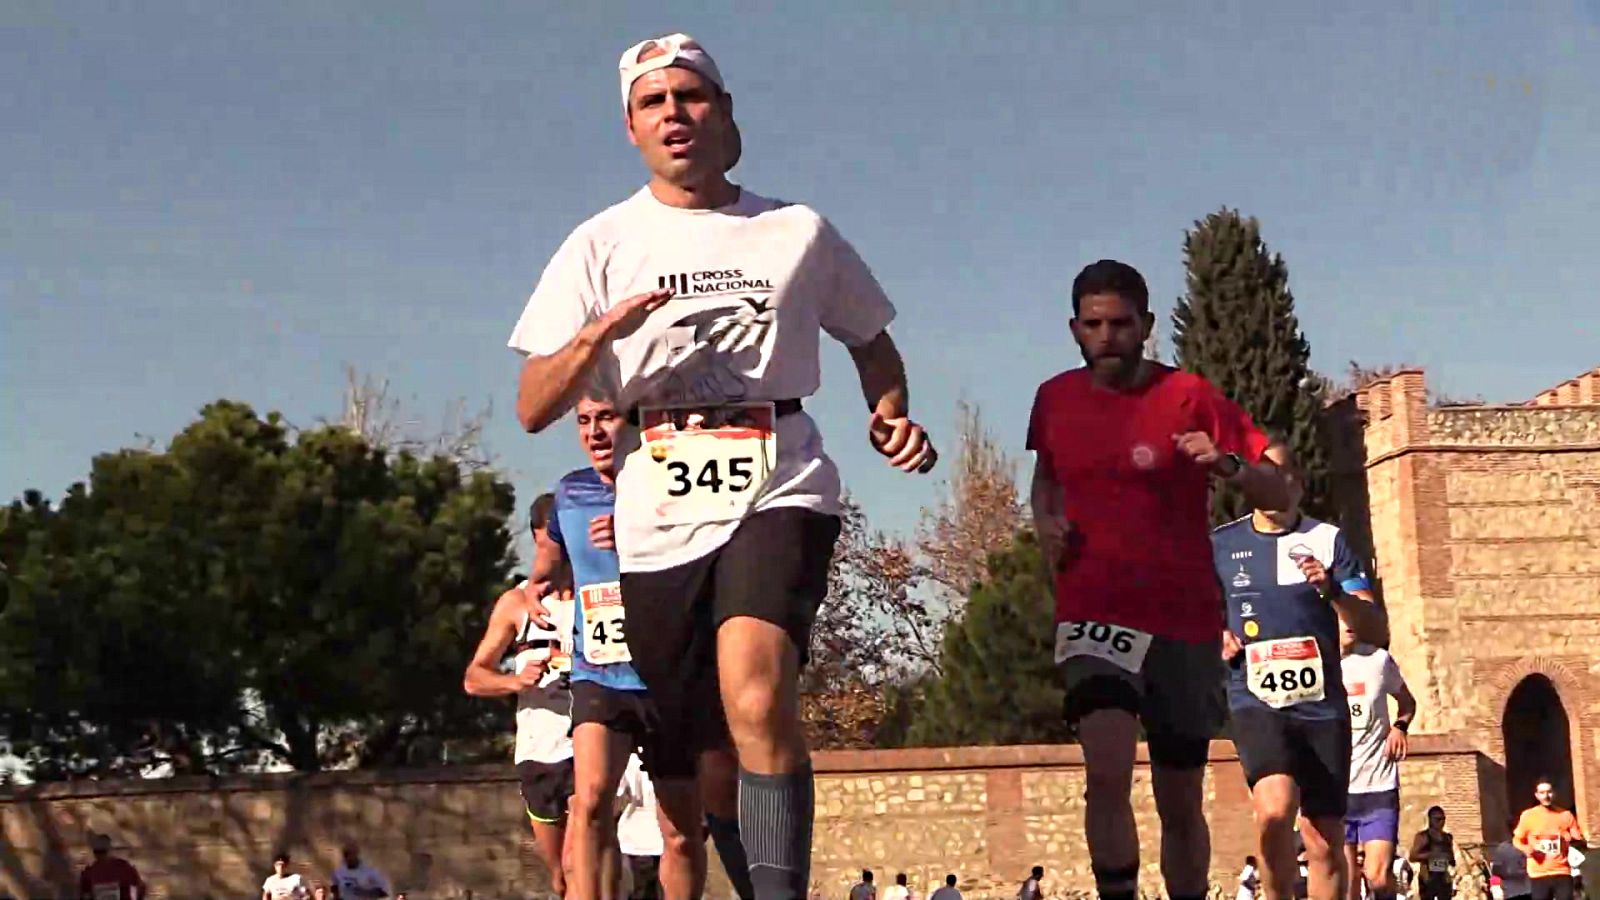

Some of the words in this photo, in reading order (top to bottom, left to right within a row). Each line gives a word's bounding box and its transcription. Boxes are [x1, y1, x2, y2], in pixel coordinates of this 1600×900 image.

[692, 269, 744, 282] CROSS
[693, 279, 774, 293] NACIONAL
[667, 457, 753, 496] 345
[1066, 621, 1136, 653] 306
[1260, 667, 1316, 692] 480
